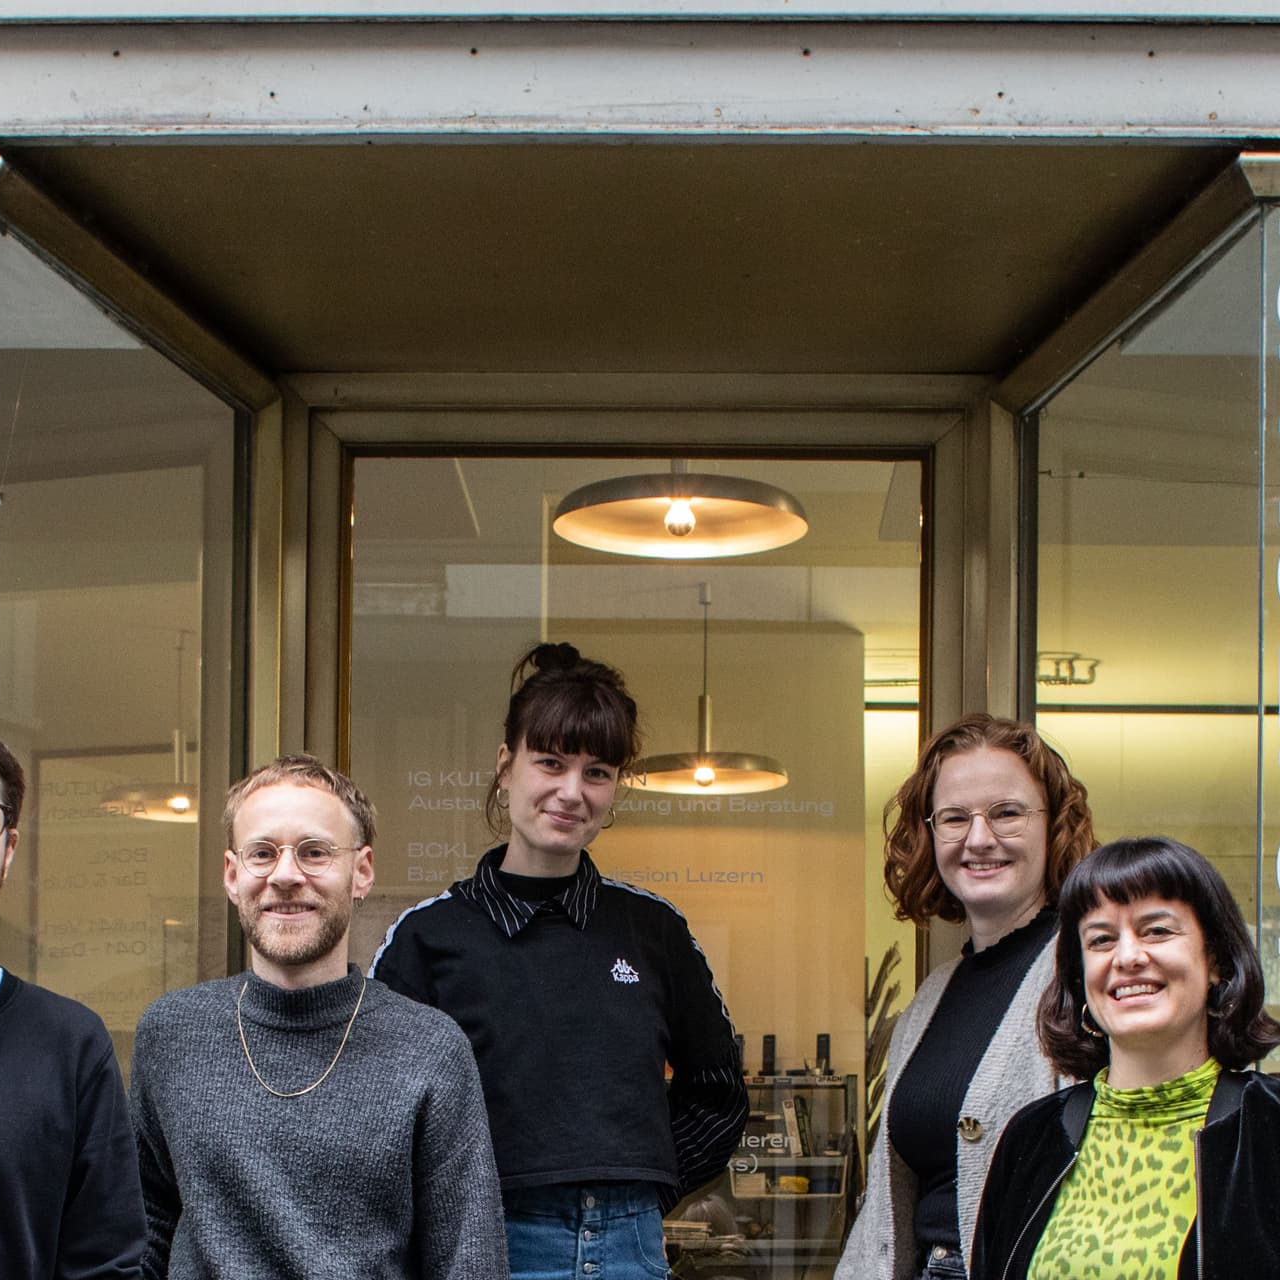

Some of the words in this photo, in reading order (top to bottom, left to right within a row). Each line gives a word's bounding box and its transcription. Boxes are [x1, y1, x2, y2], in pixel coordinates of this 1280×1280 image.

[407, 770, 433, 787] IG
[678, 796, 721, 813] und
[728, 796, 834, 818] Beratung
[407, 841, 477, 858] BCKL
[407, 866, 449, 882] Bar
[685, 866, 764, 884] Luzern
[612, 972, 641, 985] Kappa
[738, 1131, 796, 1149] ieren
